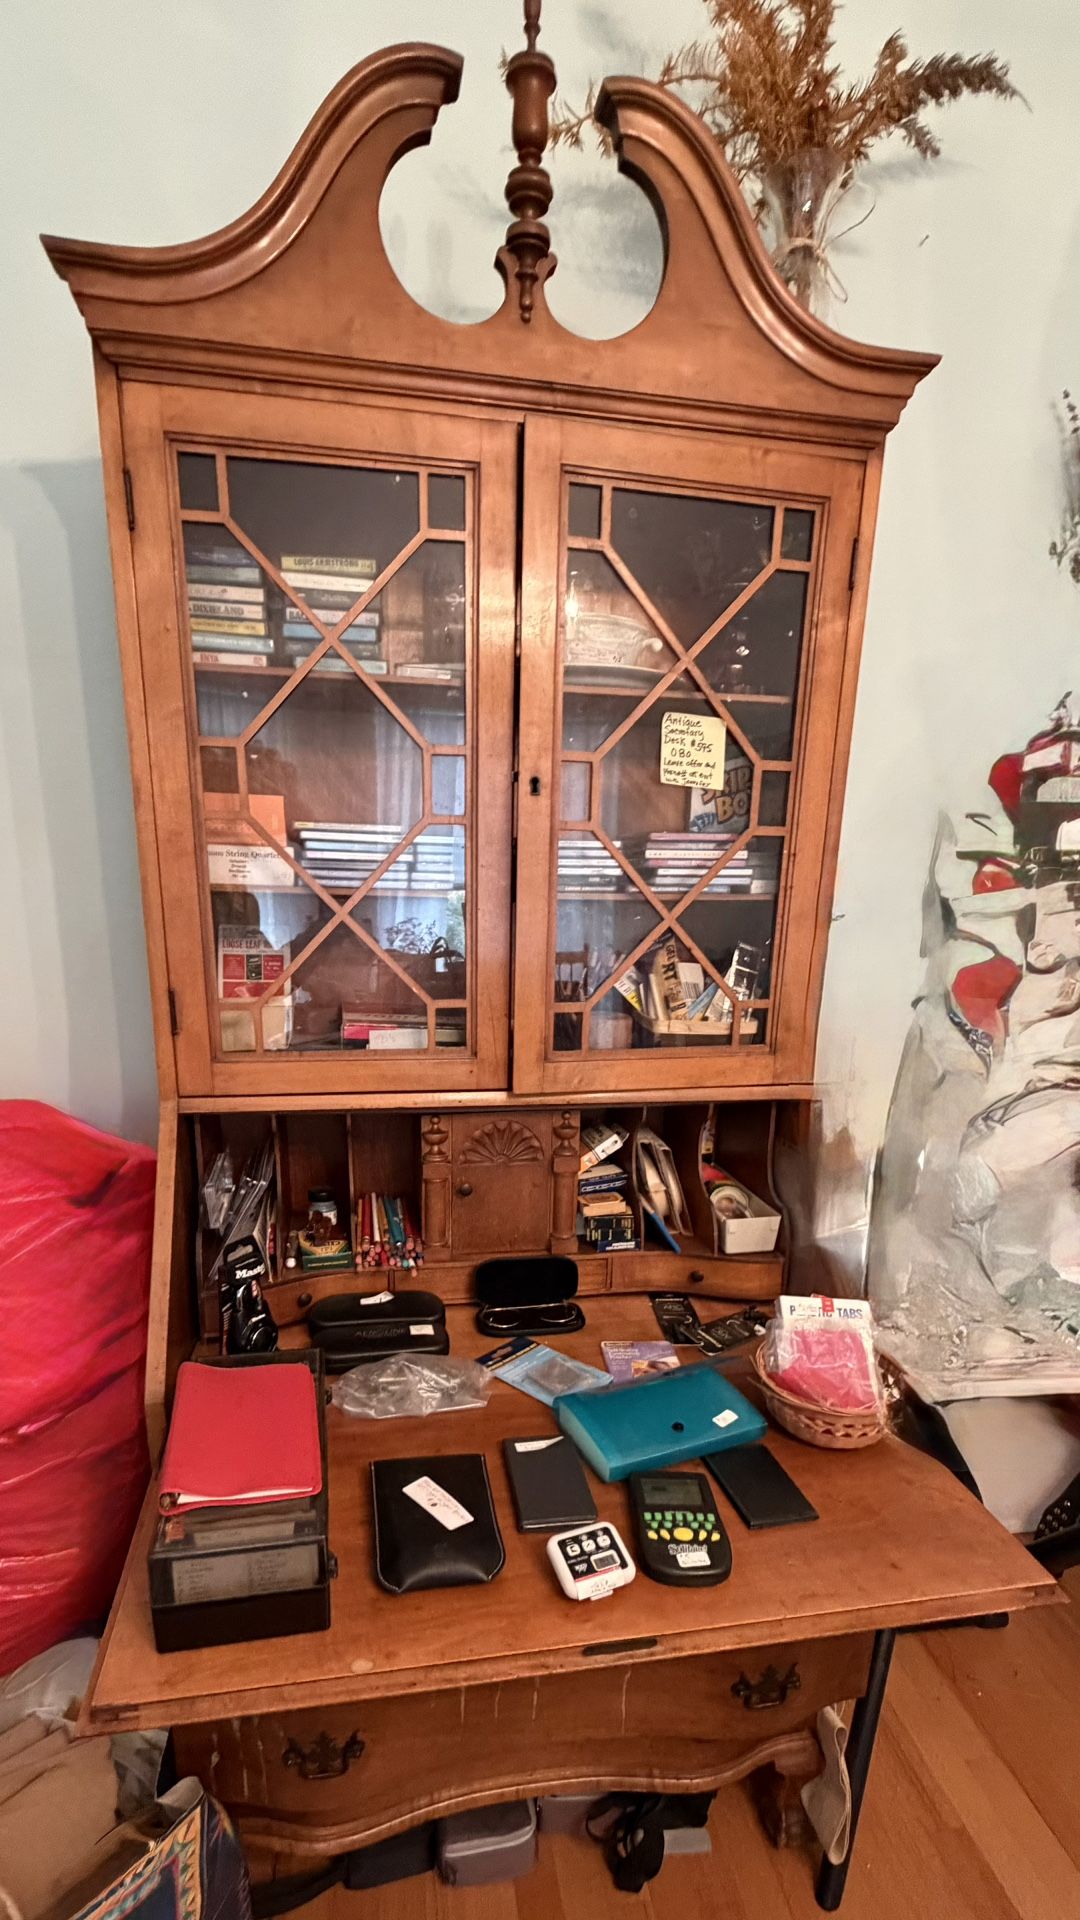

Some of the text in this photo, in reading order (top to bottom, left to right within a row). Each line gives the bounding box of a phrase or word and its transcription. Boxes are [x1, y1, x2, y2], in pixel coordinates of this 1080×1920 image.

[294, 558, 314, 567] LOUIS
[192, 603, 245, 616] DIXIELAND
[664, 714, 703, 731] Antique
[664, 734, 686, 747] Desk
[225, 848, 250, 859] String
[836, 1307, 864, 1319] TABS
